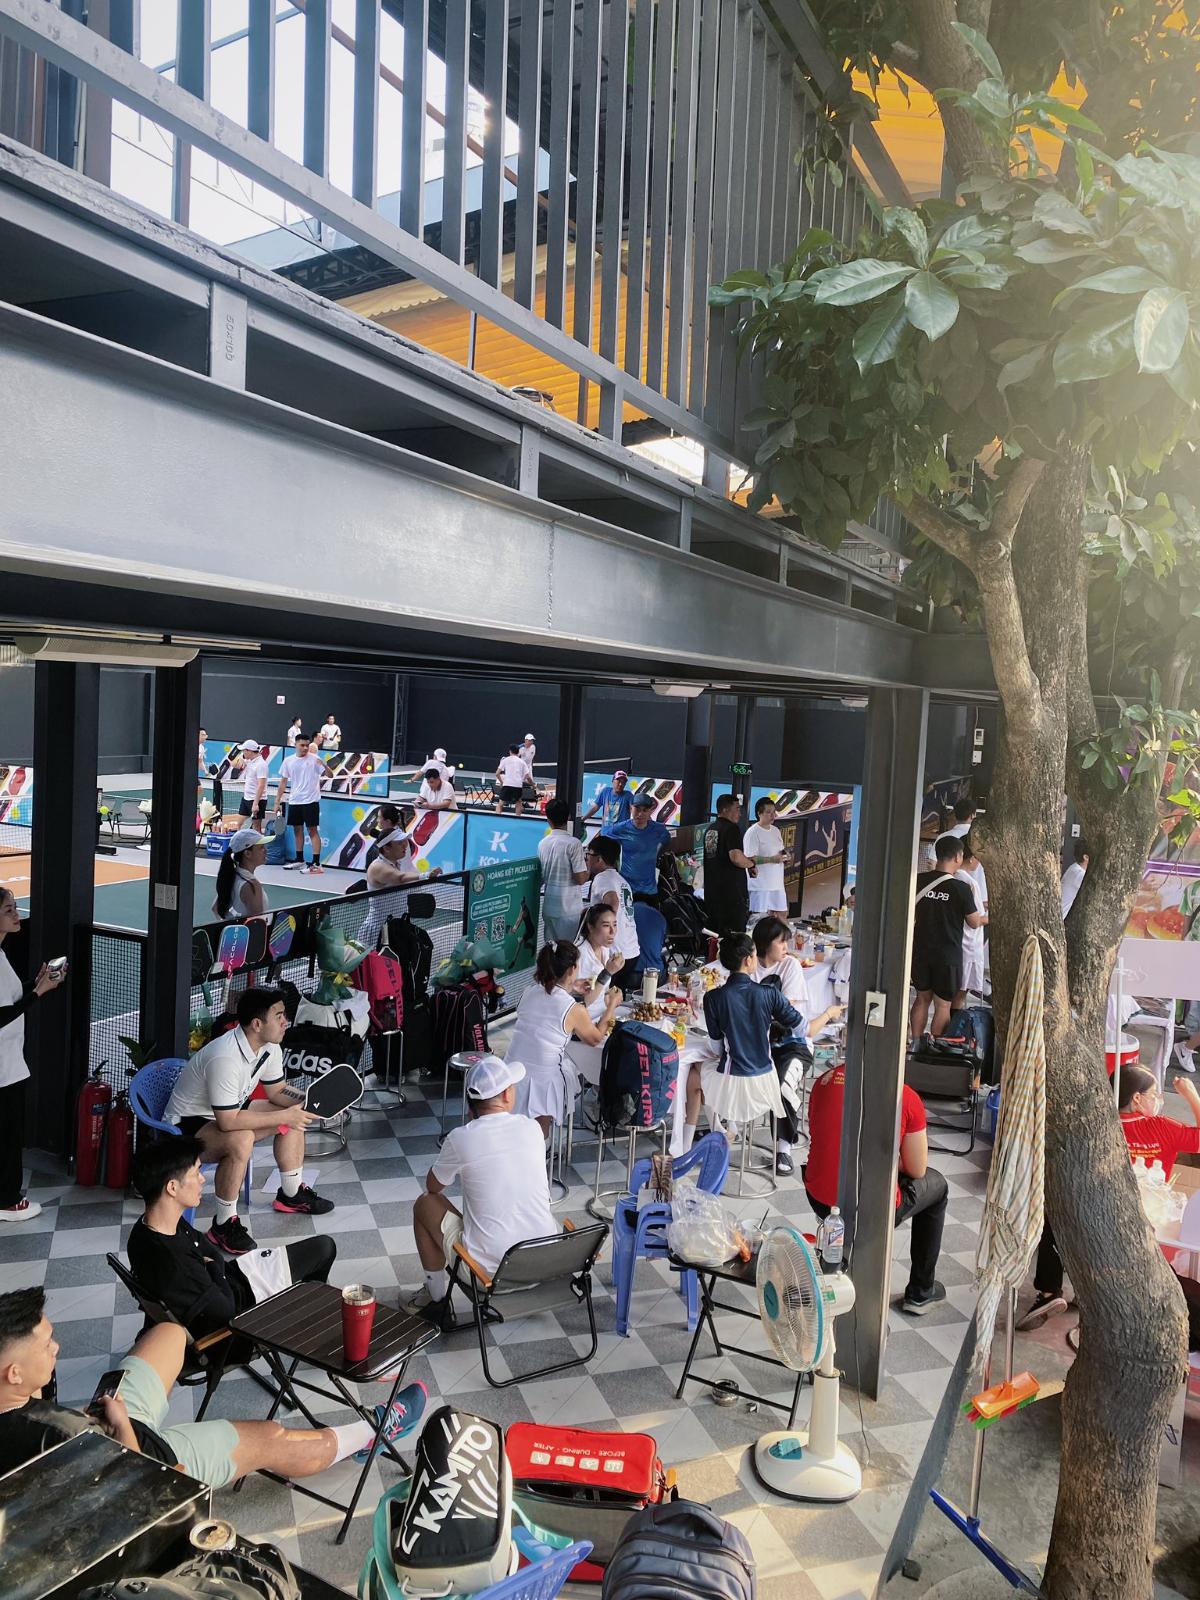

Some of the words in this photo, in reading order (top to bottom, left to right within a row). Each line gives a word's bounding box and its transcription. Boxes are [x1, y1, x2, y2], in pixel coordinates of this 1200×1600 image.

[924, 890, 950, 901] OLPB
[282, 1047, 333, 1074] idas
[533, 1441, 555, 1451] AFTER
[412, 1424, 493, 1534] KAMITO
